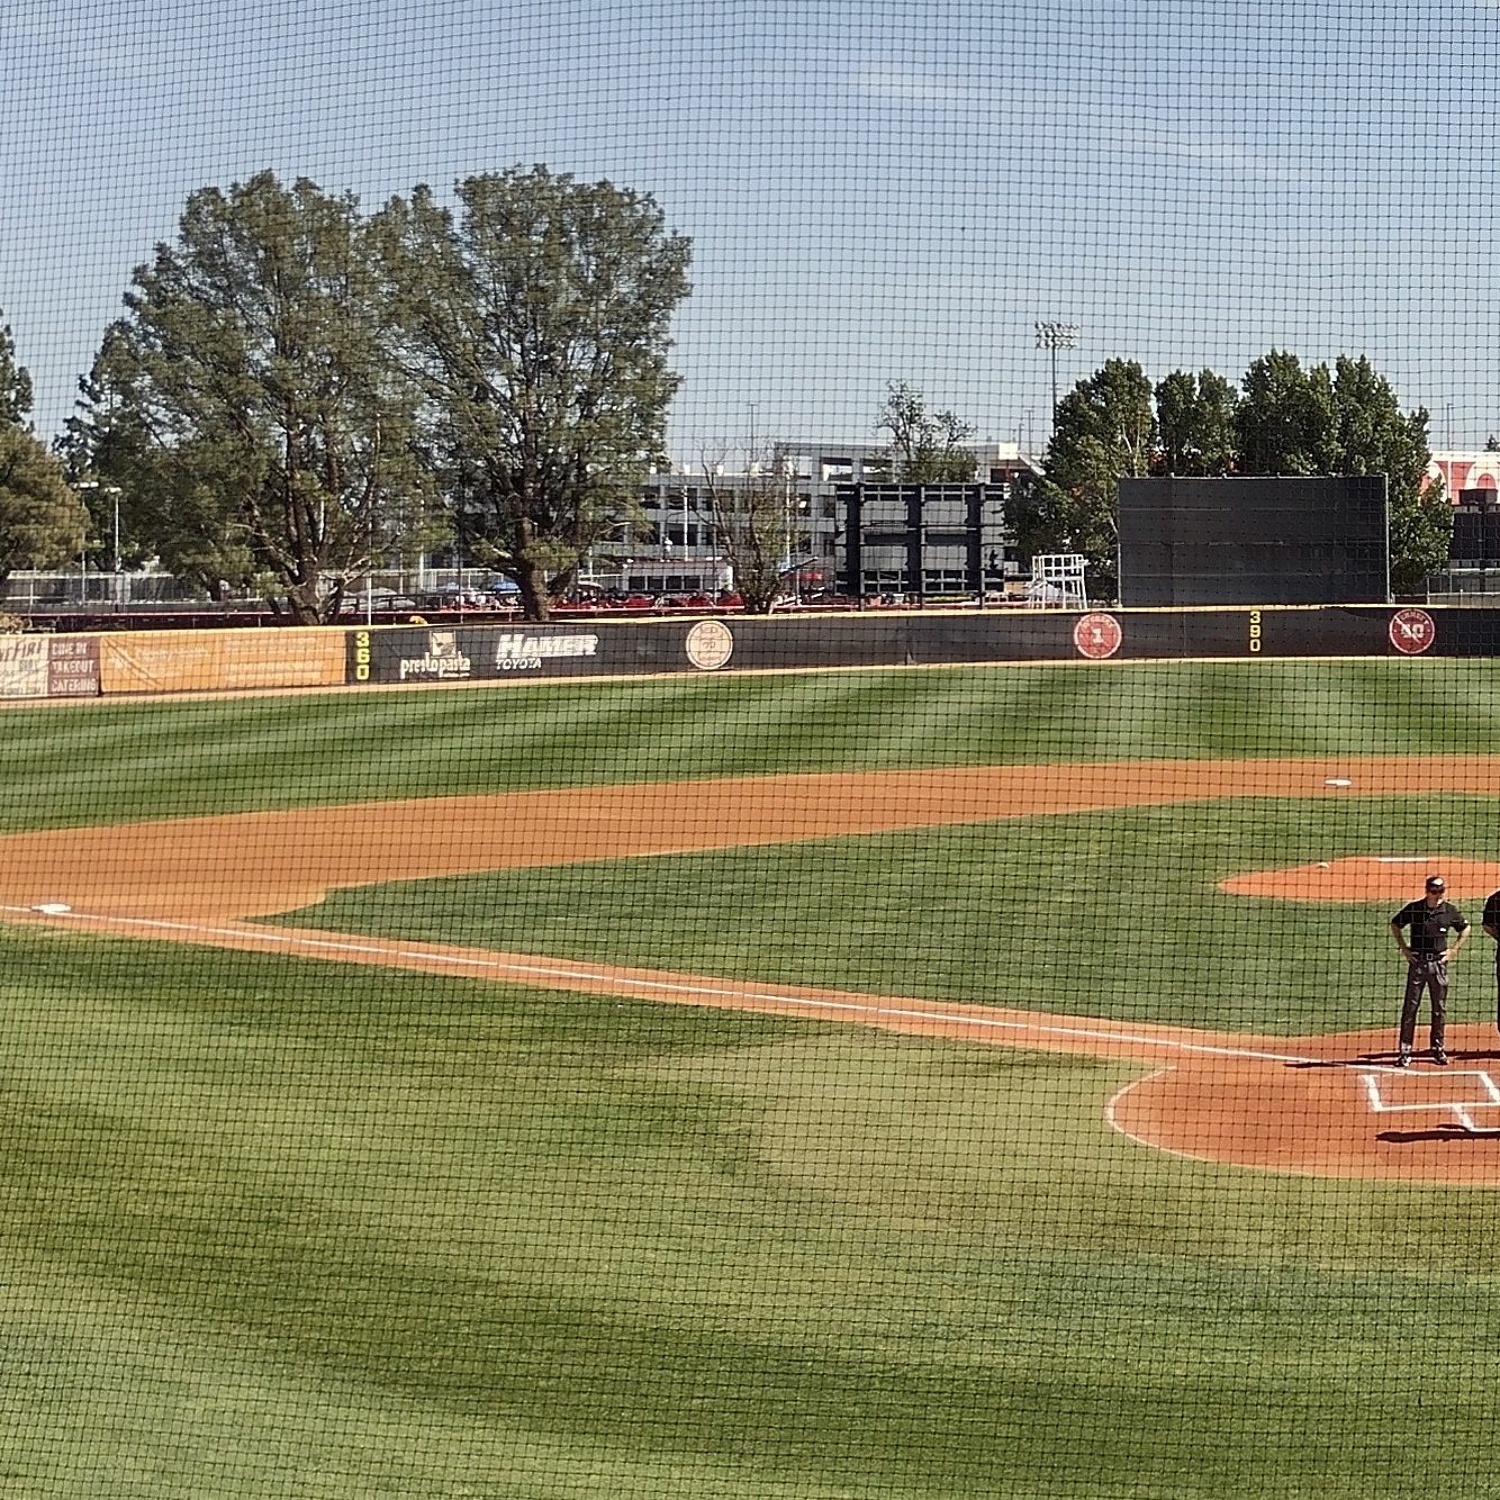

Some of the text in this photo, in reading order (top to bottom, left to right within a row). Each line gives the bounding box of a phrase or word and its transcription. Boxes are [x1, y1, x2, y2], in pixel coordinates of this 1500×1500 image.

[1250, 610, 1261, 652] 390
[497, 633, 599, 657] HAMER
[356, 631, 370, 680] 360
[496, 658, 542, 670] TOYOTA
[51, 660, 94, 673] TAKEOUT
[51, 678, 97, 692] CATERING
